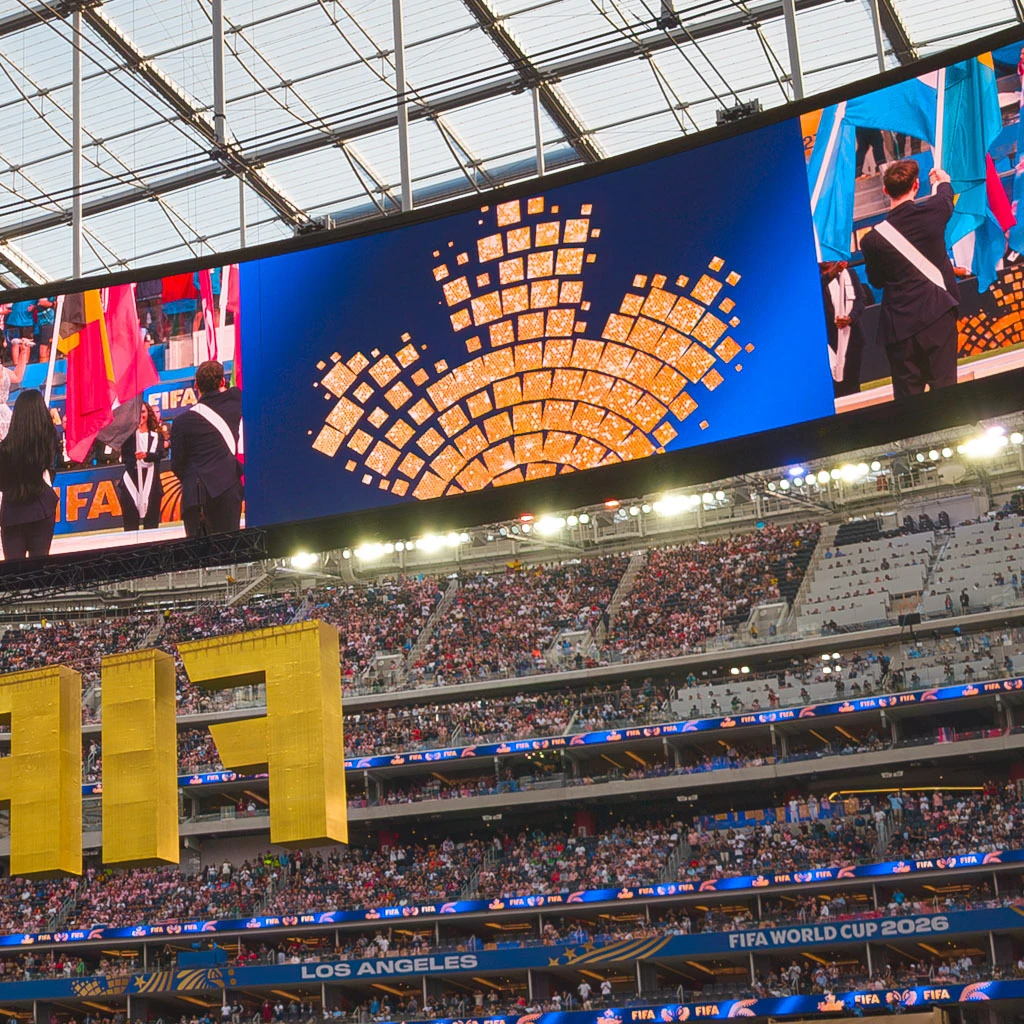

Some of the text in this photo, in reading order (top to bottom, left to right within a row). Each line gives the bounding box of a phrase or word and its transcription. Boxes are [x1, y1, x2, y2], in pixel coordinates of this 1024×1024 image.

[804, 134, 816, 149] 2
[148, 387, 198, 410] FIFA
[52, 480, 122, 522] IFA
[984, 683, 1001, 692] FIFA
[900, 694, 915, 703] FIFA
[860, 699, 875, 708] FIFA
[779, 710, 794, 719] FIFA
[741, 715, 756, 724] FIFA
[626, 728, 641, 737] FIFA
[663, 724, 677, 733] FIFA
[516, 741, 530, 750] FIFA
[551, 737, 566, 746] FIFA
[409, 753, 423, 761] FIFA
[443, 749, 457, 758] FIFA
[207, 774, 219, 782] FIFA
[960, 856, 977, 865] FIFA
[916, 861, 933, 870] FIFA
[774, 874, 791, 884] FIFA
[815, 870, 832, 879] FIFA
[638, 887, 654, 896] FIFA
[678, 883, 694, 892] FIFA
[509, 898, 524, 907] FIFA
[547, 895, 562, 904] FIFA
[385, 908, 399, 917] FIFA
[421, 905, 436, 914] FIFA
[266, 917, 280, 926] FIFA
[301, 914, 315, 923] FIFA
[150, 925, 164, 934] FIFA
[184, 923, 197, 932] FIFA
[71, 931, 84, 939] FIFA
[728, 916, 949, 949] FIFA WORLD CUP 2026
[38, 933, 51, 942] FIFA
[301, 954, 478, 979] LOS ANGELES
[923, 989, 950, 1000] FIFA
[854, 994, 880, 1005] FIFA
[631, 1009, 655, 1020] FIFA
[695, 1005, 719, 1016] FIFA
